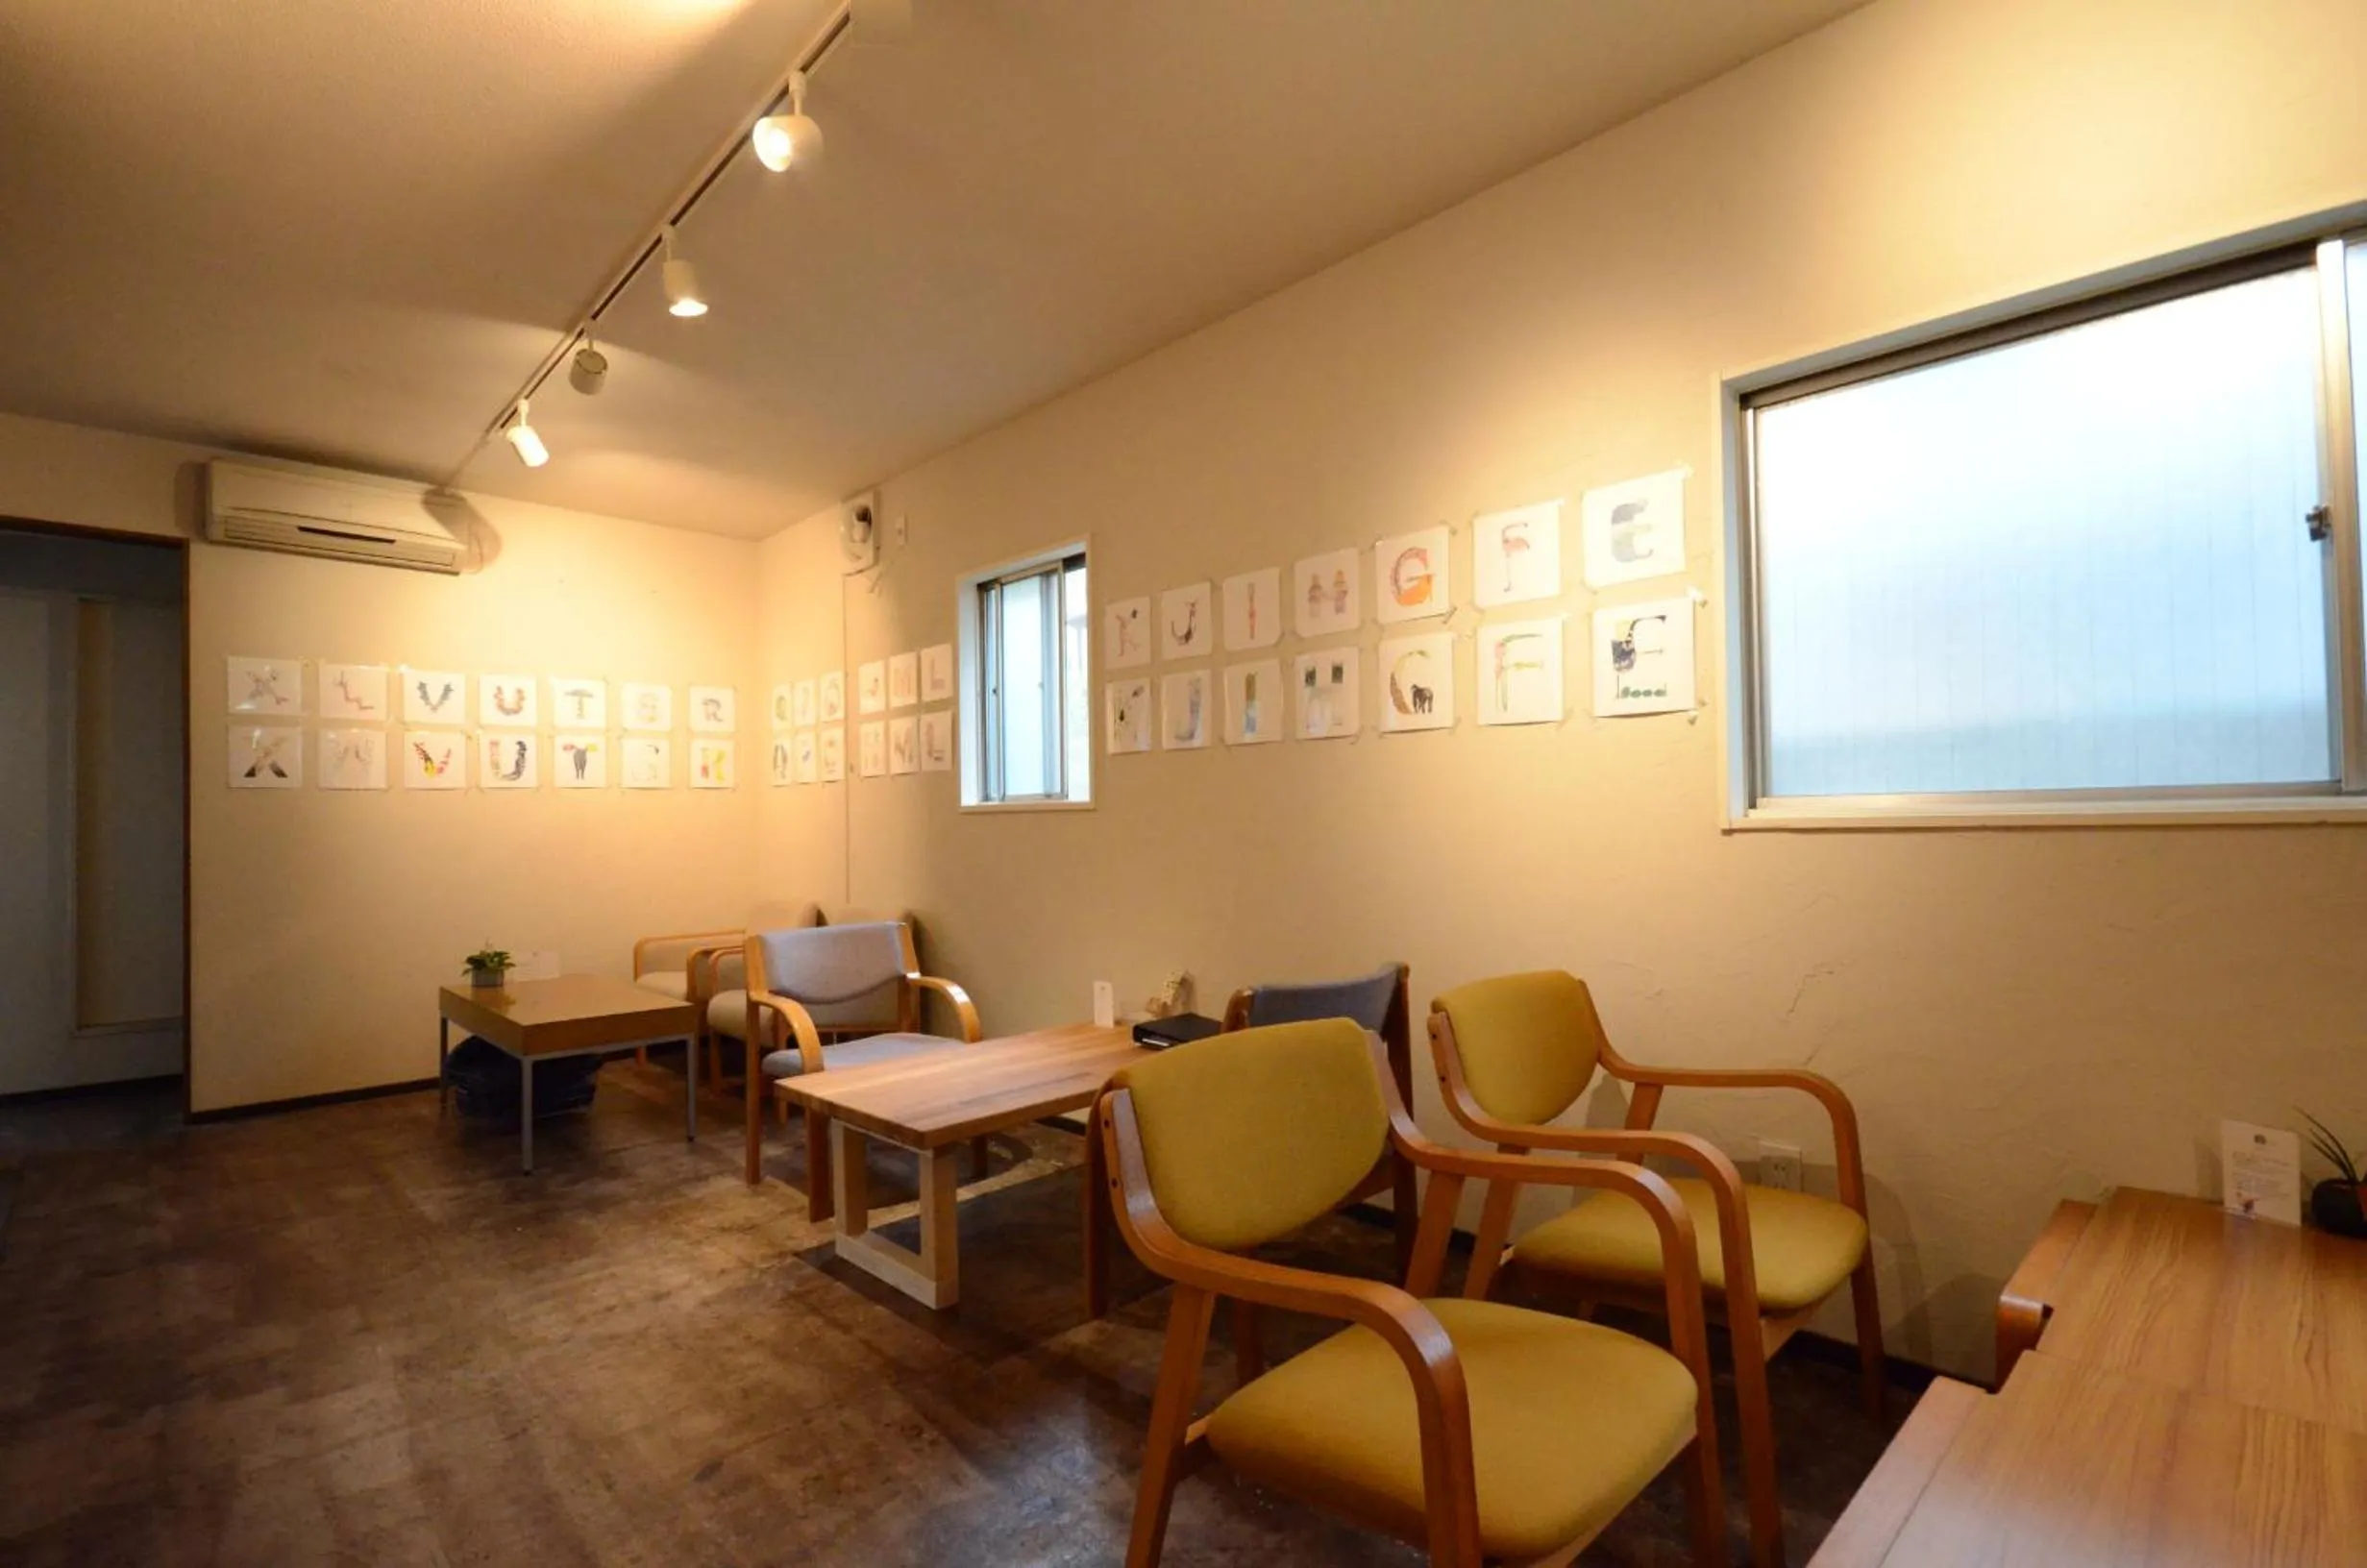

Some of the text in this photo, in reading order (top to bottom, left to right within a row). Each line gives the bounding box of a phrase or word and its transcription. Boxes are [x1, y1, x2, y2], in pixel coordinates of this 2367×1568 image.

[1390, 546, 1435, 606] G
[417, 680, 454, 712] V
[493, 685, 526, 716] U
[564, 689, 594, 720] T
[702, 698, 724, 723] R
